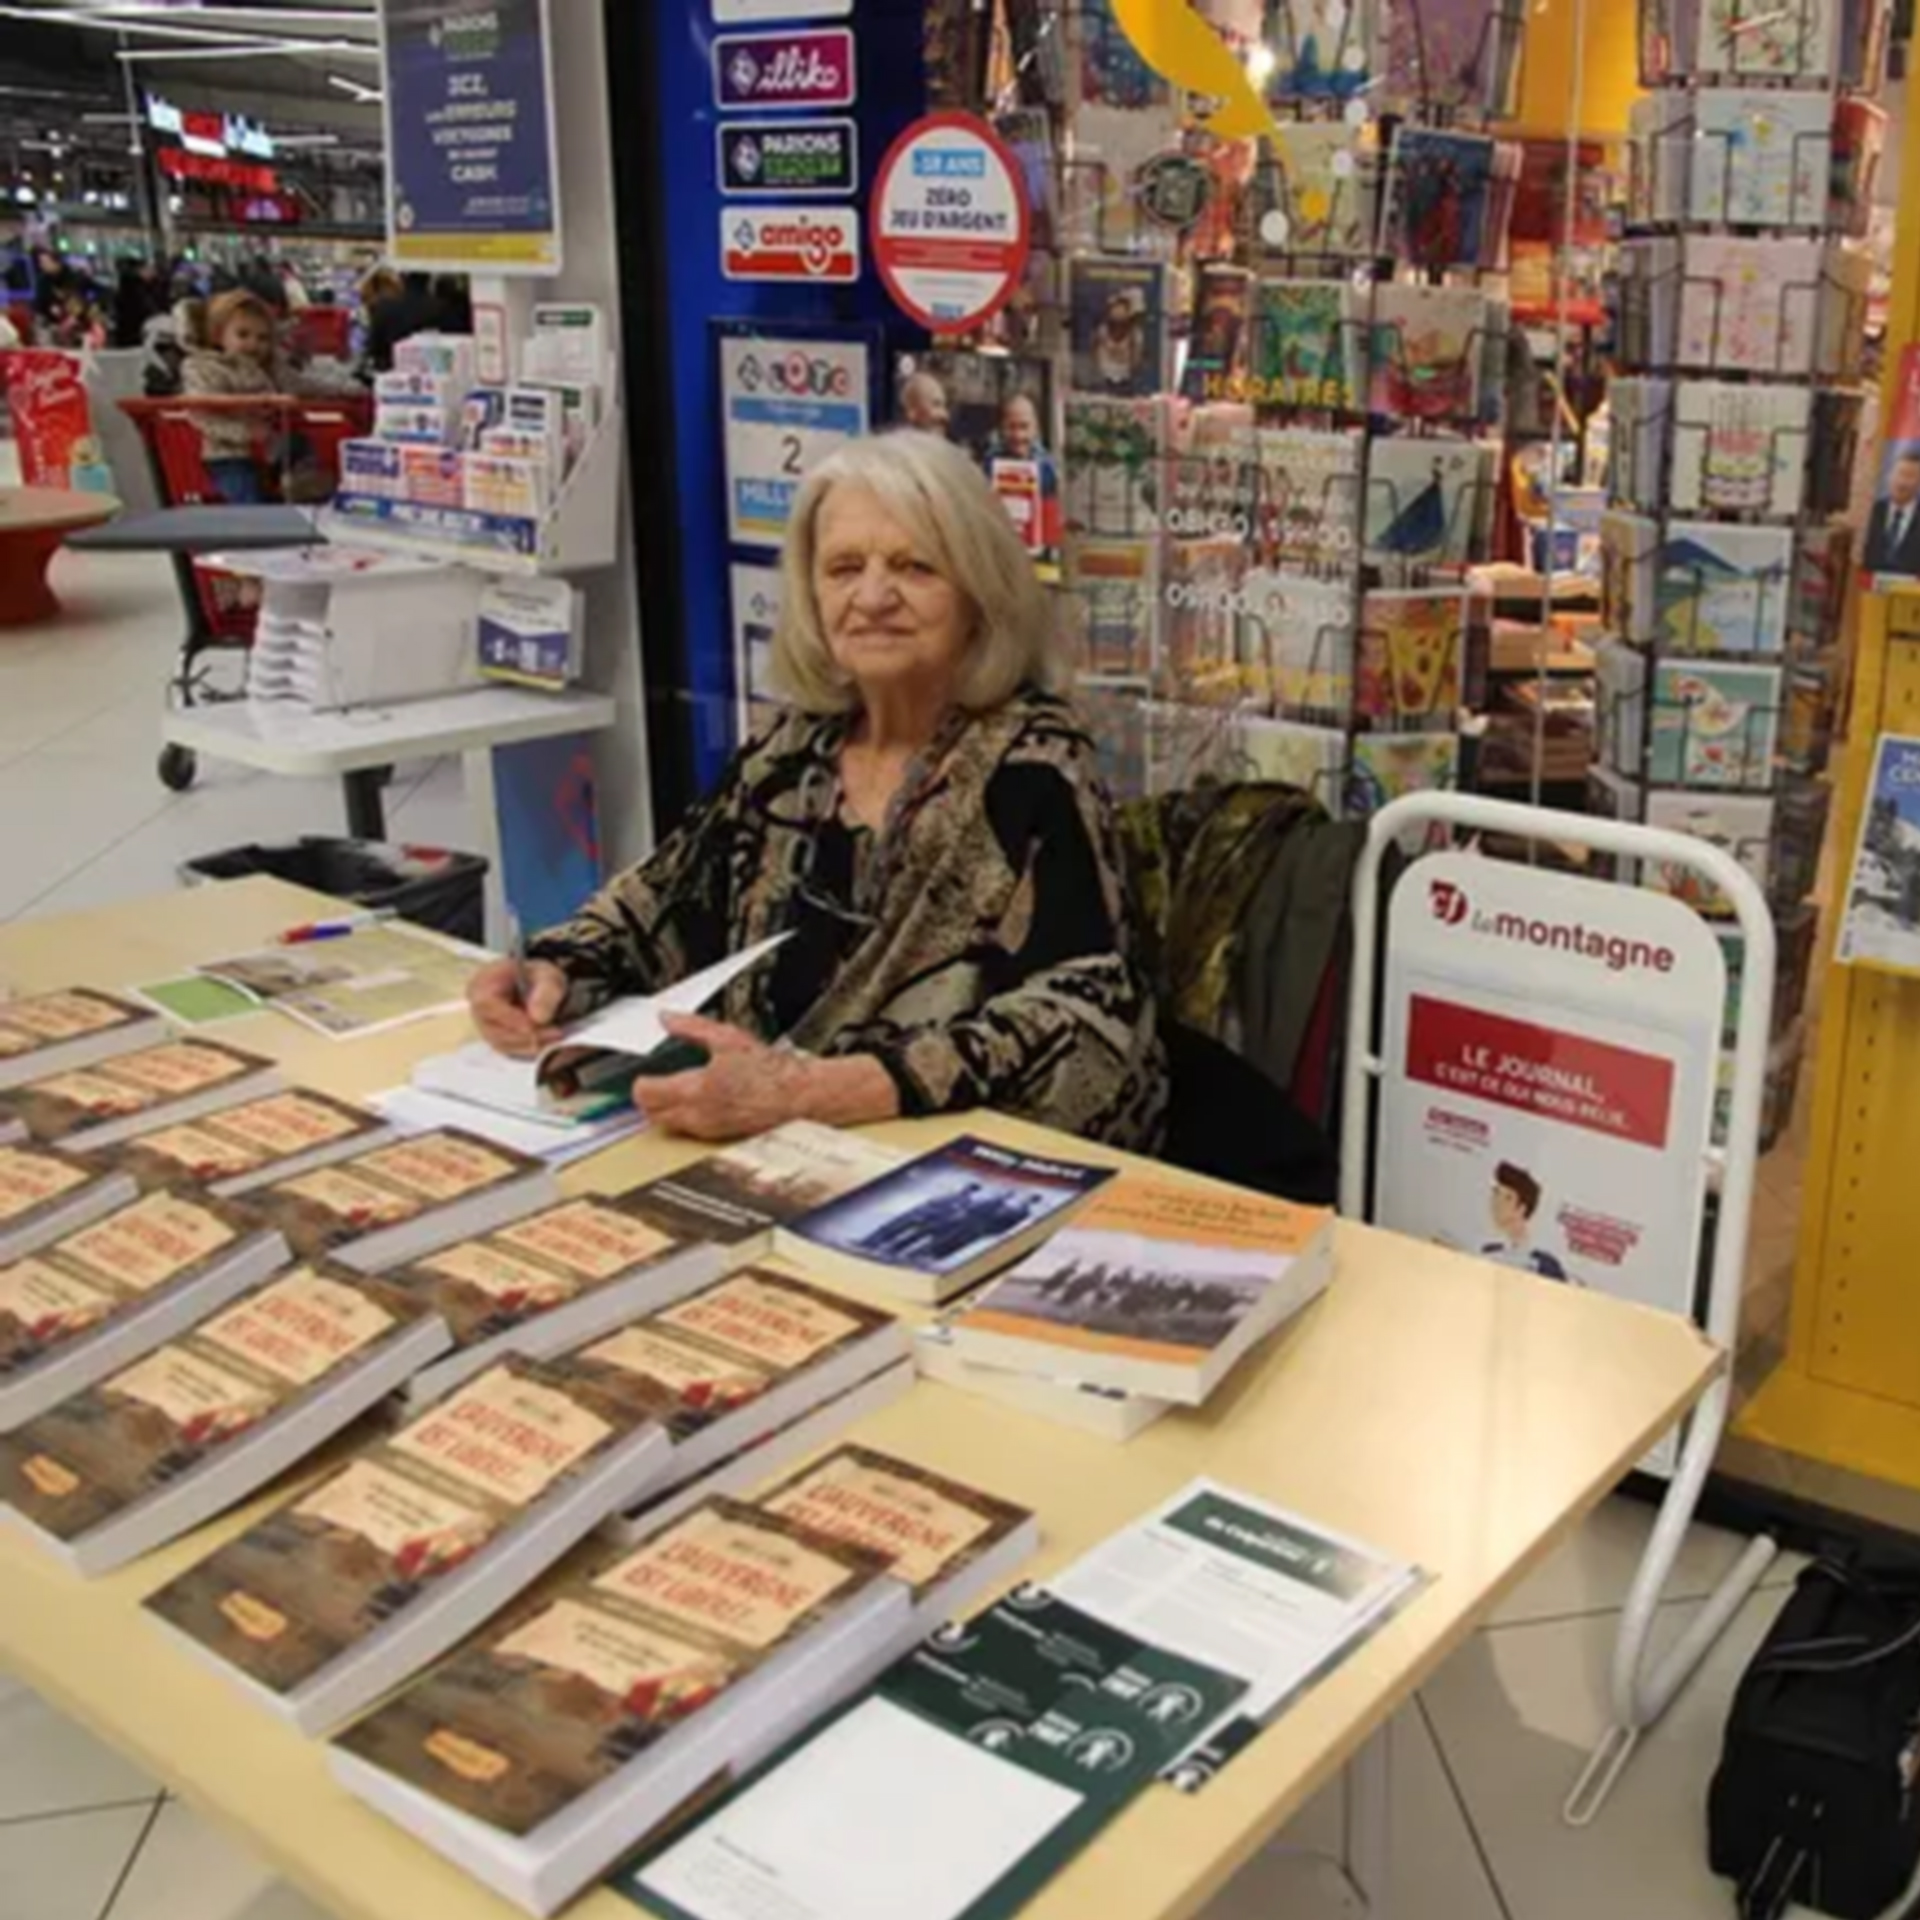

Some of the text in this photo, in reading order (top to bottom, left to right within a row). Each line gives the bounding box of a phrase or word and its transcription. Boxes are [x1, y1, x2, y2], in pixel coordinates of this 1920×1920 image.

[760, 214, 844, 268] amigo
[781, 433, 803, 476] 2
[1496, 912, 1675, 973] montagne
[1460, 1044, 1490, 1069] LE
